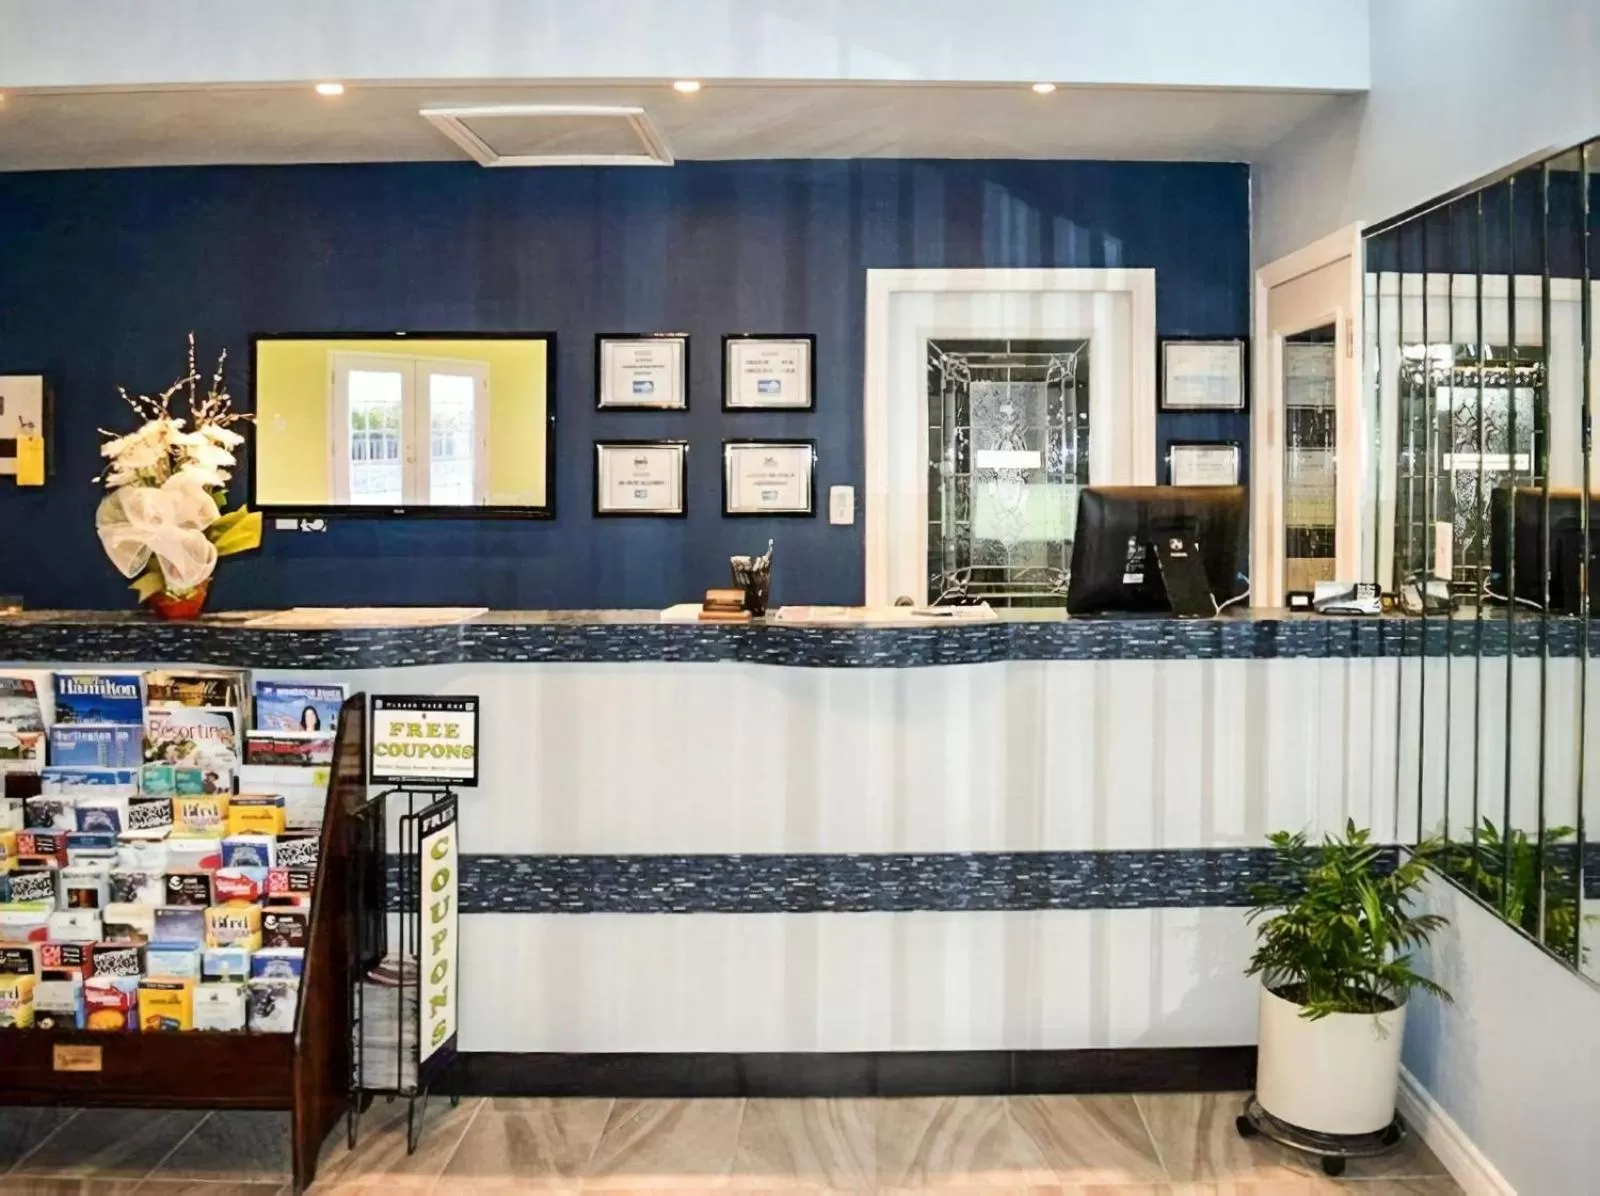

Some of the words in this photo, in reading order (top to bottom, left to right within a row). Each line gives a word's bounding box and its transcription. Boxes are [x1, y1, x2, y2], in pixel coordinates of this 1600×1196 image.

[60, 677, 137, 696] Hamilton
[389, 721, 461, 739] FREE
[374, 742, 474, 760] COUPONS
[429, 835, 451, 1047] COUPONS
